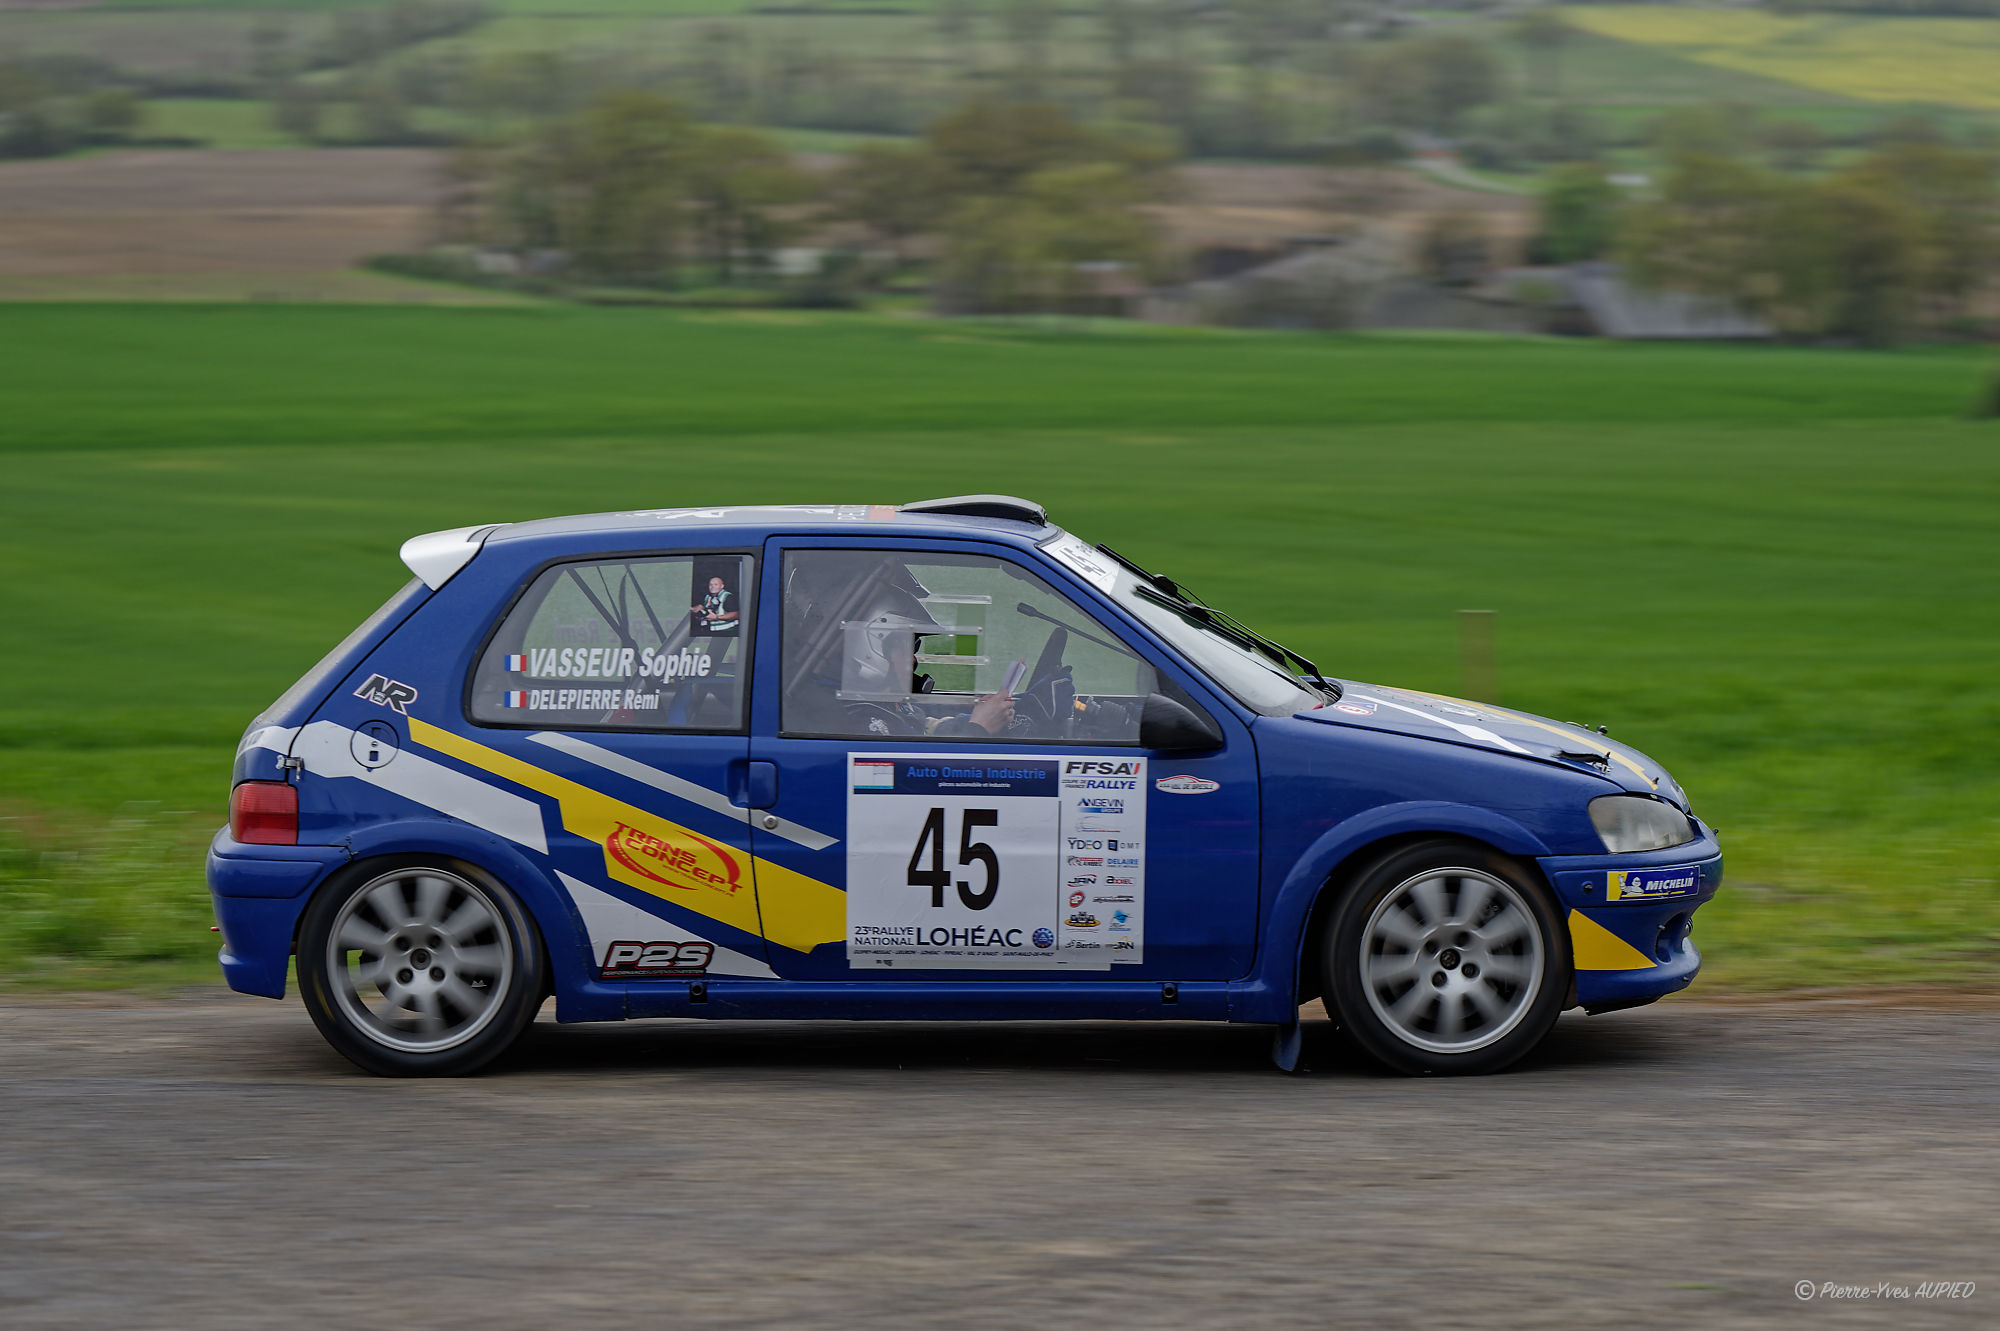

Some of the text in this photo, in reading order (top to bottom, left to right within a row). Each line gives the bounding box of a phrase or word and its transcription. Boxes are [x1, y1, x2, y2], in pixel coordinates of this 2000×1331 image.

[529, 647, 711, 684] VASSEUR Sophie
[529, 689, 660, 710] DELEPIERRE Rémi
[906, 766, 1046, 780] Auto Omnia Industrie
[1065, 761, 1132, 775] FFSA
[1086, 780, 1137, 790] RALLYE
[1077, 798, 1124, 807] ANGEVIN
[614, 821, 697, 864] TRANS
[1067, 839, 1102, 850] YDEO
[625, 838, 744, 893] CONCEPT
[907, 807, 999, 911] 45
[1645, 877, 1694, 891] MICHELIN
[855, 937, 914, 946] NATIONAL
[916, 925, 1023, 948] LOHÉAC
[605, 944, 711, 969] P2S
